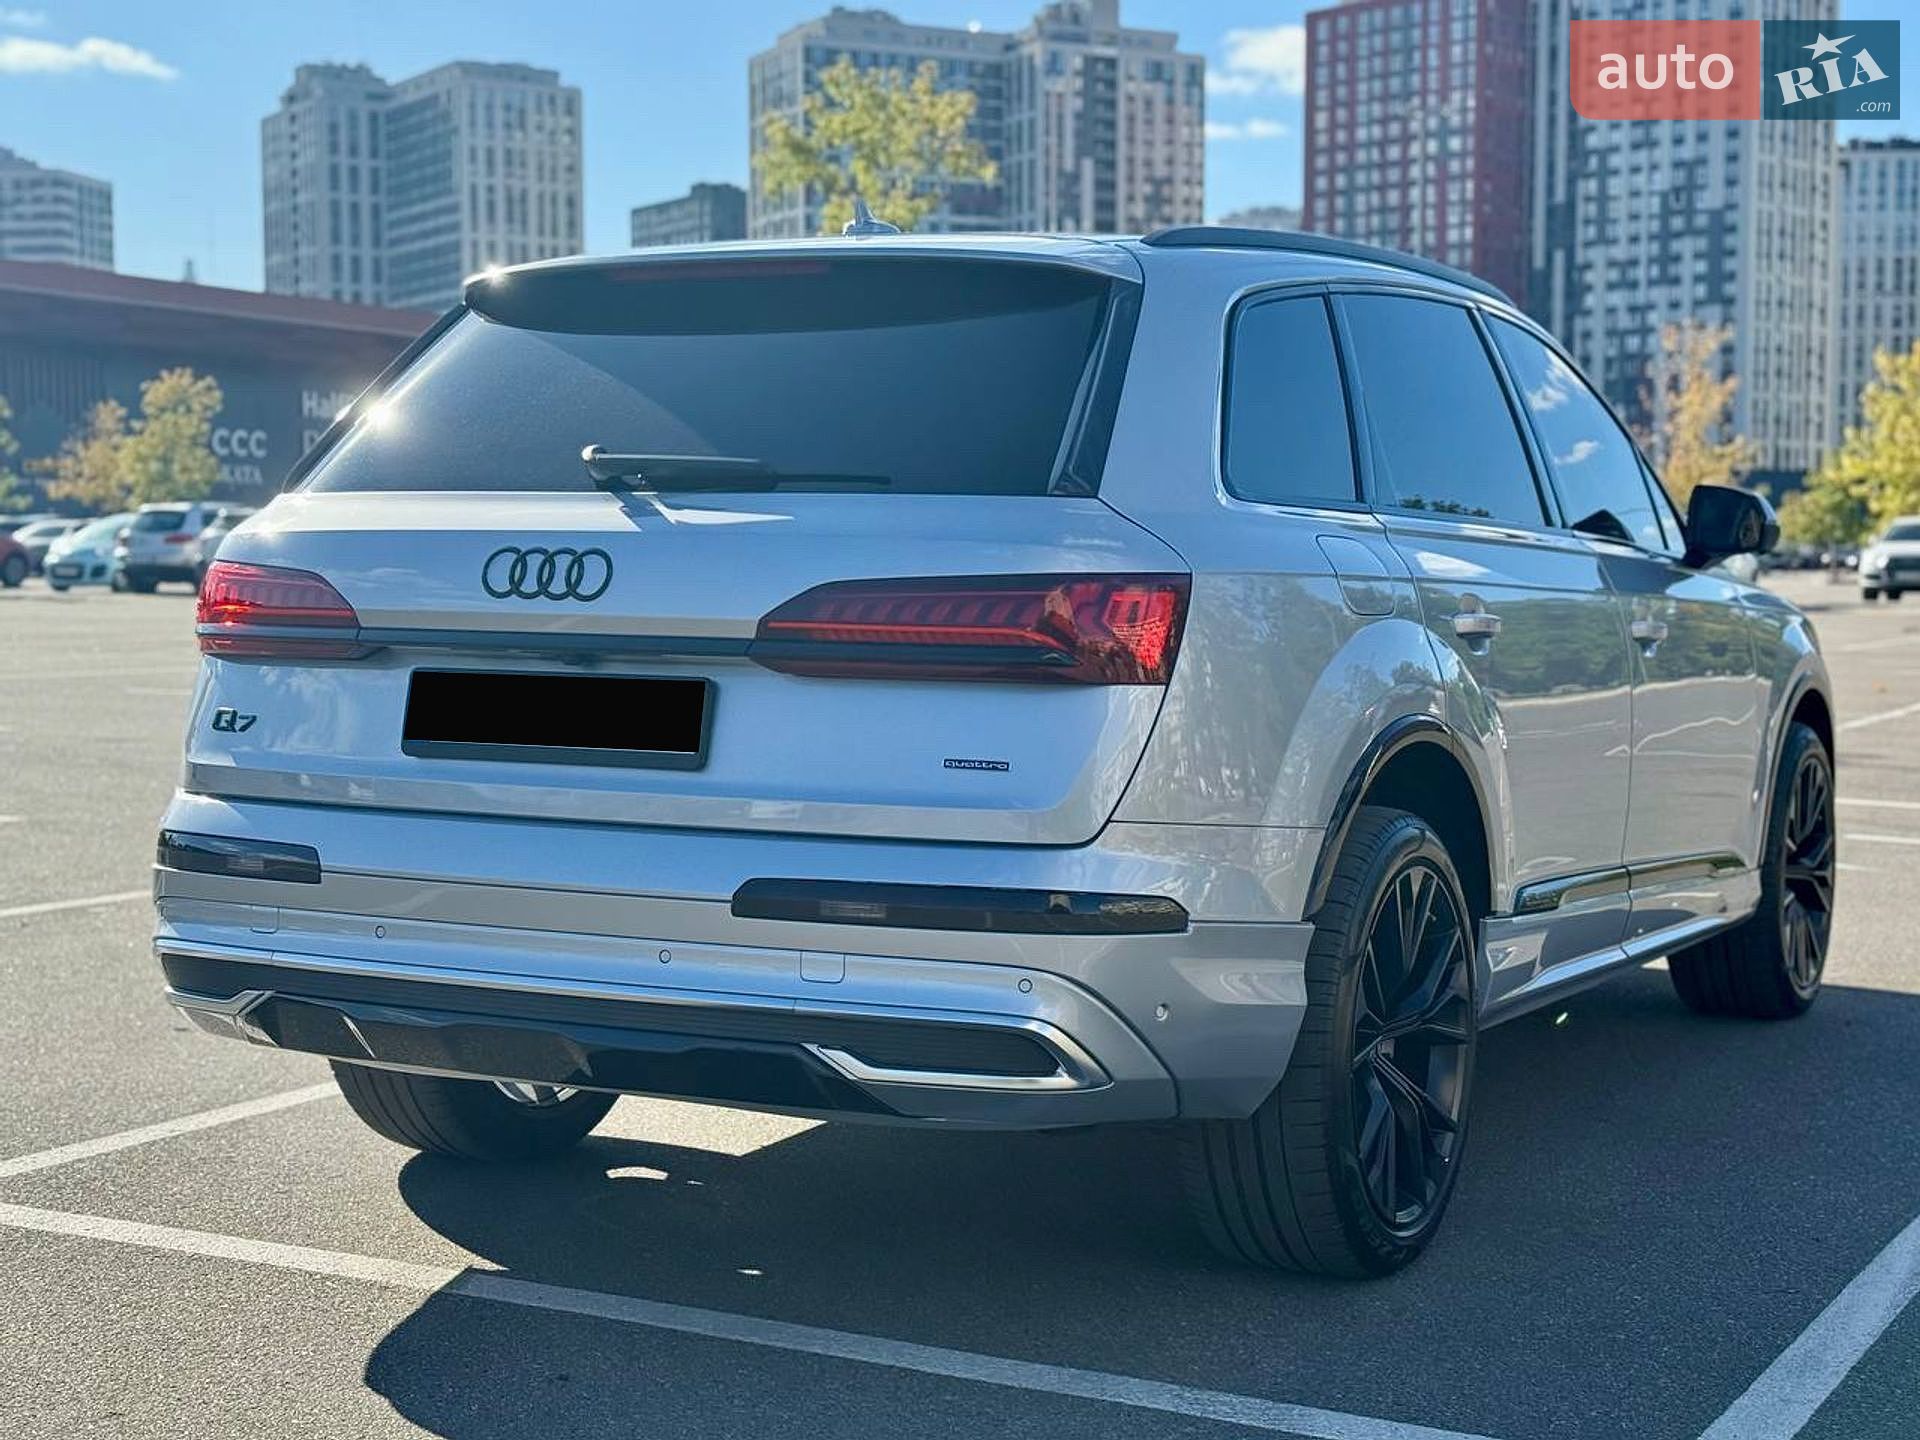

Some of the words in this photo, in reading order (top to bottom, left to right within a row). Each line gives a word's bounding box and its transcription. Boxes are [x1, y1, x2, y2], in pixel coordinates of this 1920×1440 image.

[211, 427, 268, 458] CCC
[212, 707, 258, 733] Q7
[944, 759, 1008, 770] quattro
